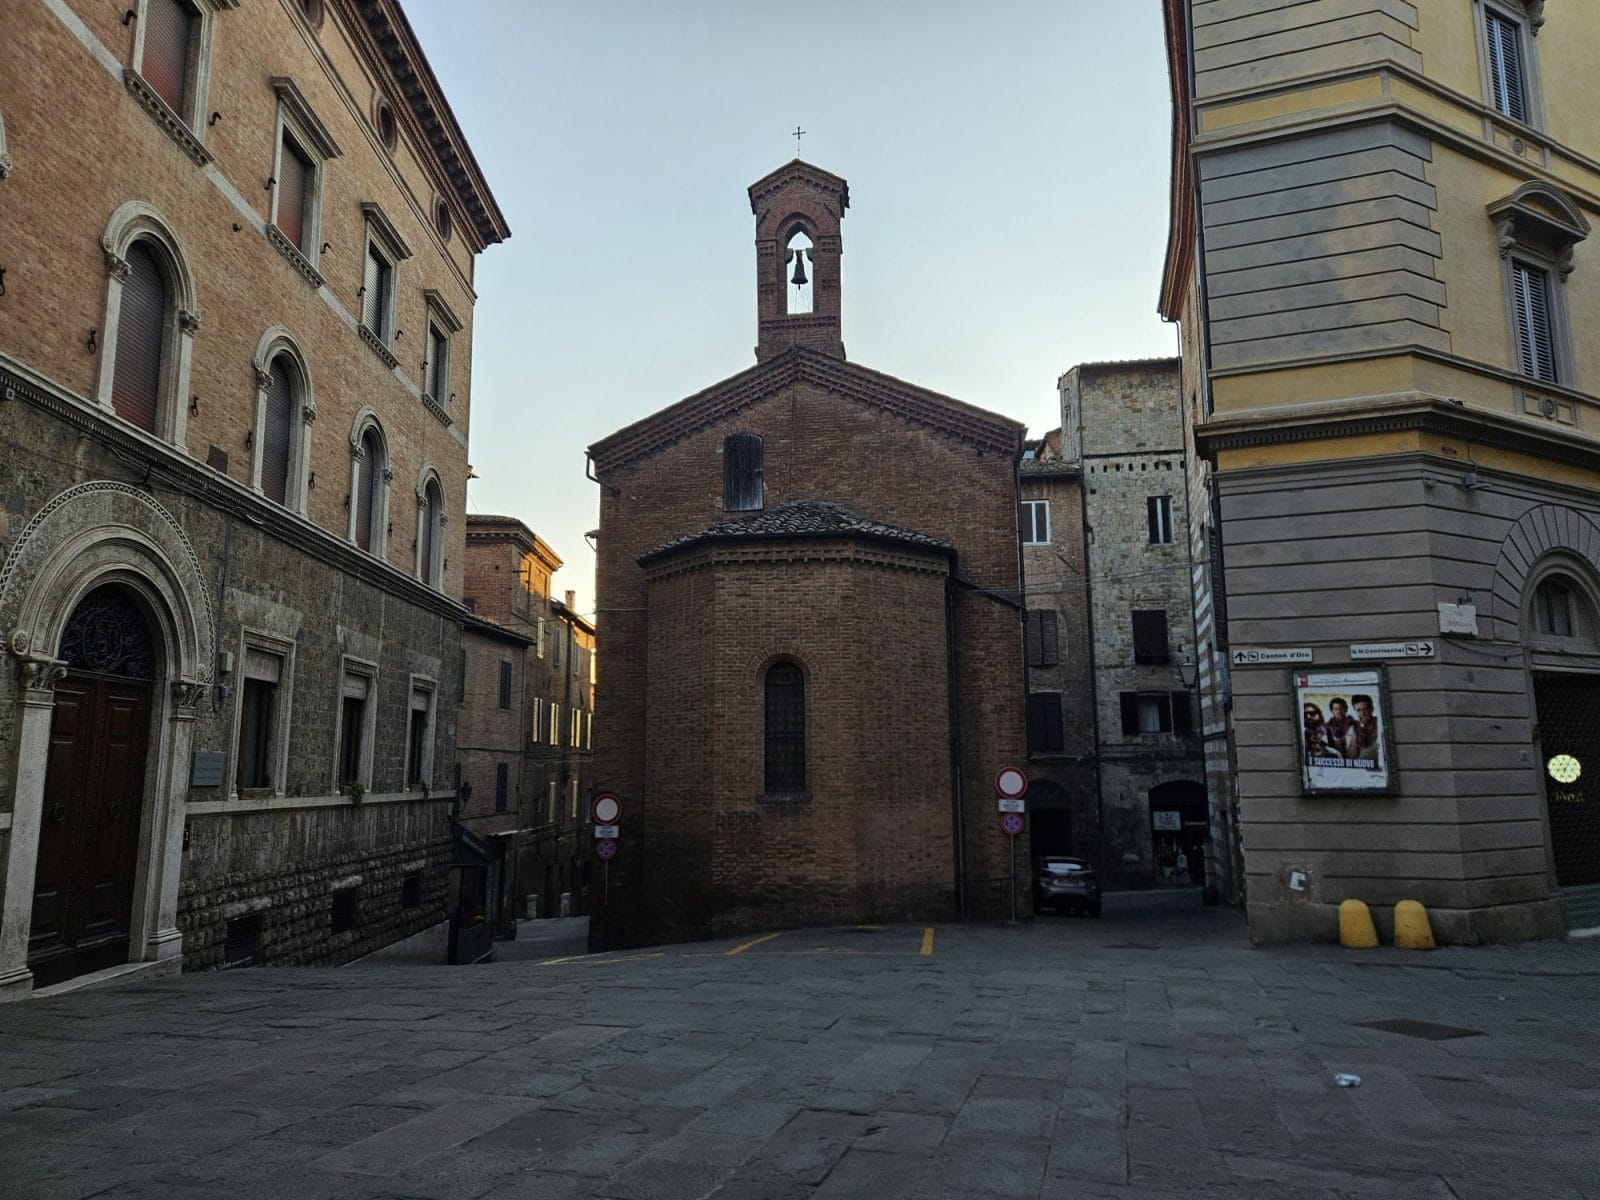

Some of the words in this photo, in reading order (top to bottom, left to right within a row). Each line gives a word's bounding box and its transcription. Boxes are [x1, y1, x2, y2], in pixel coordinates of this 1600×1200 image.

[1314, 757, 1345, 767] SUCCESSO
[1345, 758, 1353, 767] DI
[1353, 759, 1375, 768] NUOVO
